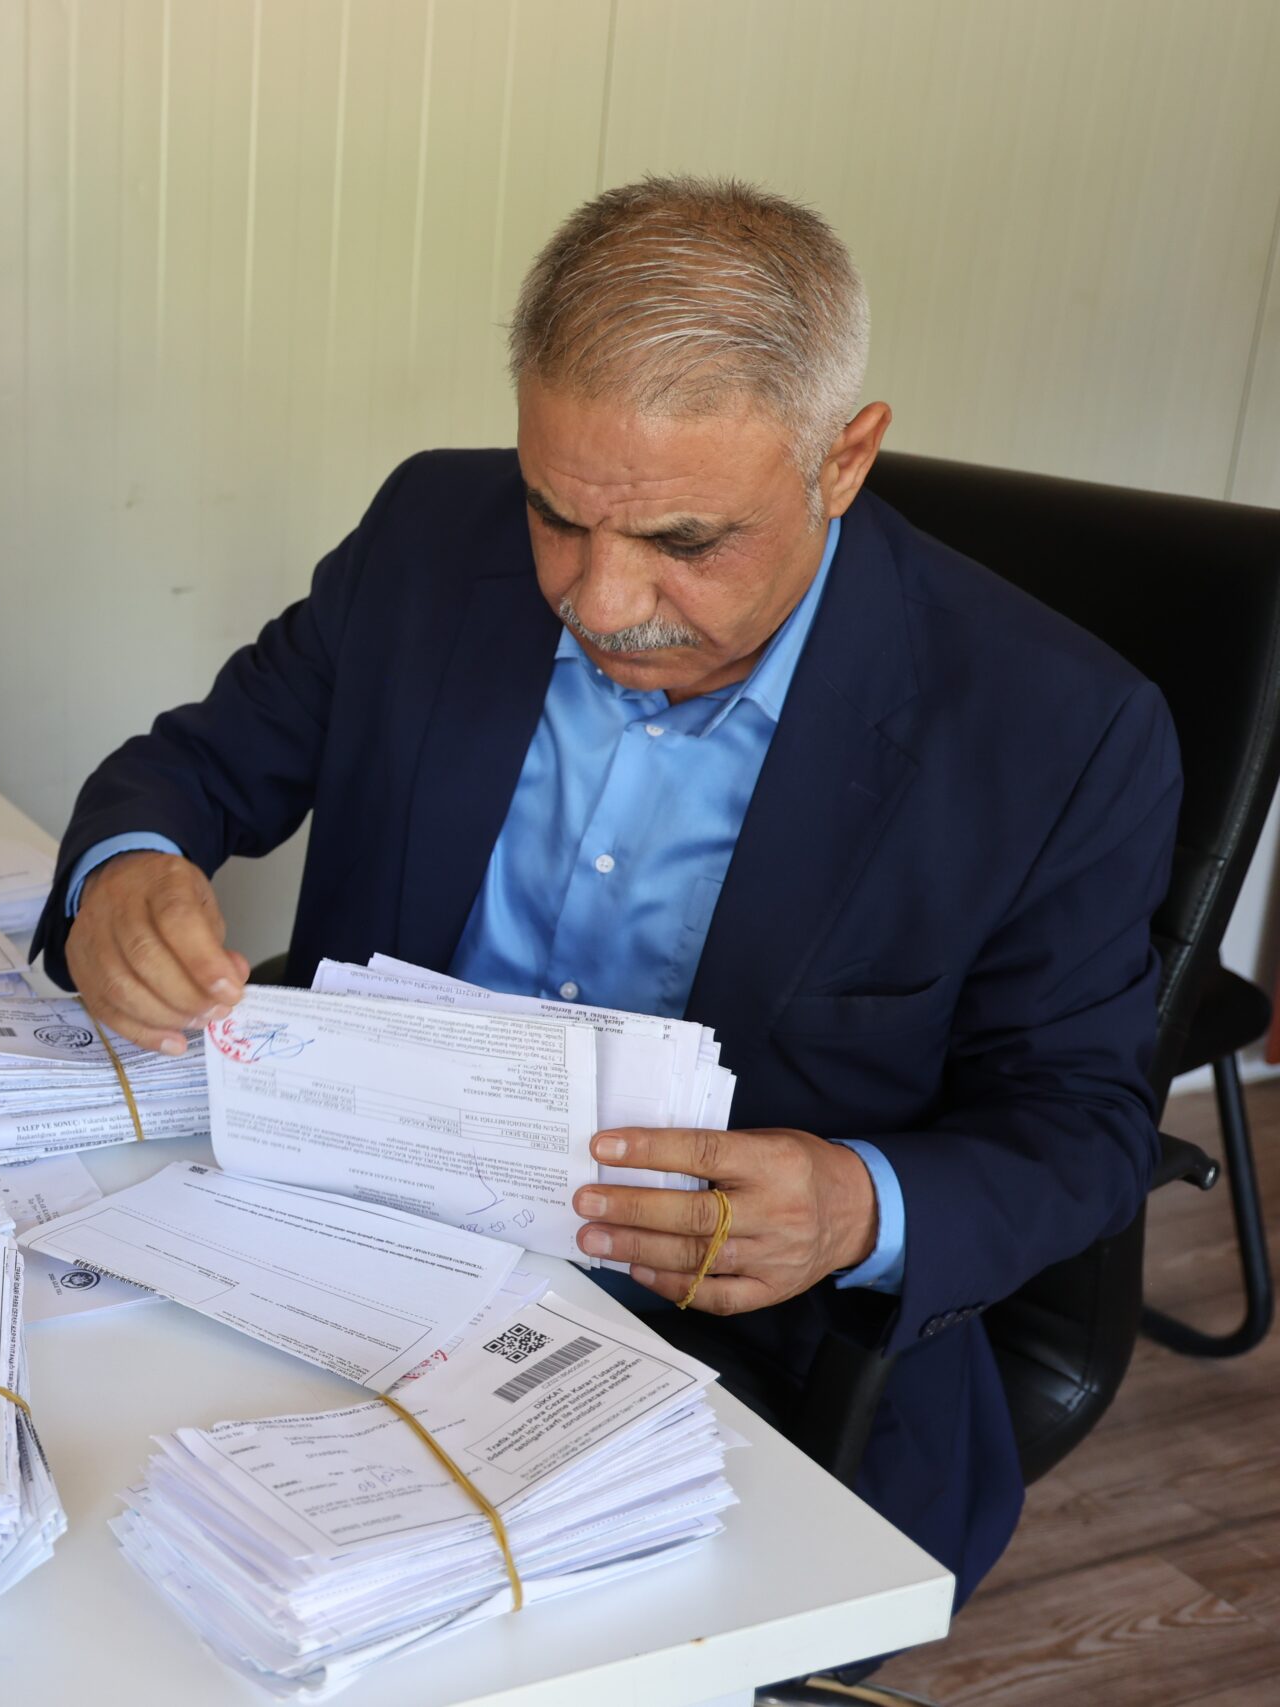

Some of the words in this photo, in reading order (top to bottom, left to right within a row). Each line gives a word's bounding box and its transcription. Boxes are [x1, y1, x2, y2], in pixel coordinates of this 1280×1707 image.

[539, 1003, 572, 1014] üzerinden
[575, 1008, 587, 1016] kur
[15, 1123, 40, 1134] TALEP
[40, 1122, 51, 1131] VE
[485, 1434, 510, 1454] Trafik
[507, 1421, 529, 1440] İdari
[526, 1409, 547, 1427] Para
[545, 1392, 574, 1415] Cezası
[571, 1378, 594, 1398] Karar
[592, 1356, 628, 1384] Tutanağı
[485, 1431, 527, 1463] ödemeleri
[524, 1420, 544, 1437] için,
[542, 1402, 571, 1426] ödeme
[568, 1376, 611, 1409] birimlerine
[608, 1355, 644, 1383] giderken
[532, 1385, 564, 1411] DİKKAT
[512, 1427, 547, 1455] tebligat
[544, 1416, 564, 1434] zarfı
[561, 1409, 575, 1423] ile
[572, 1386, 609, 1415] müracaat
[607, 1371, 633, 1393] etmek
[559, 1397, 605, 1430] zorunludur.
